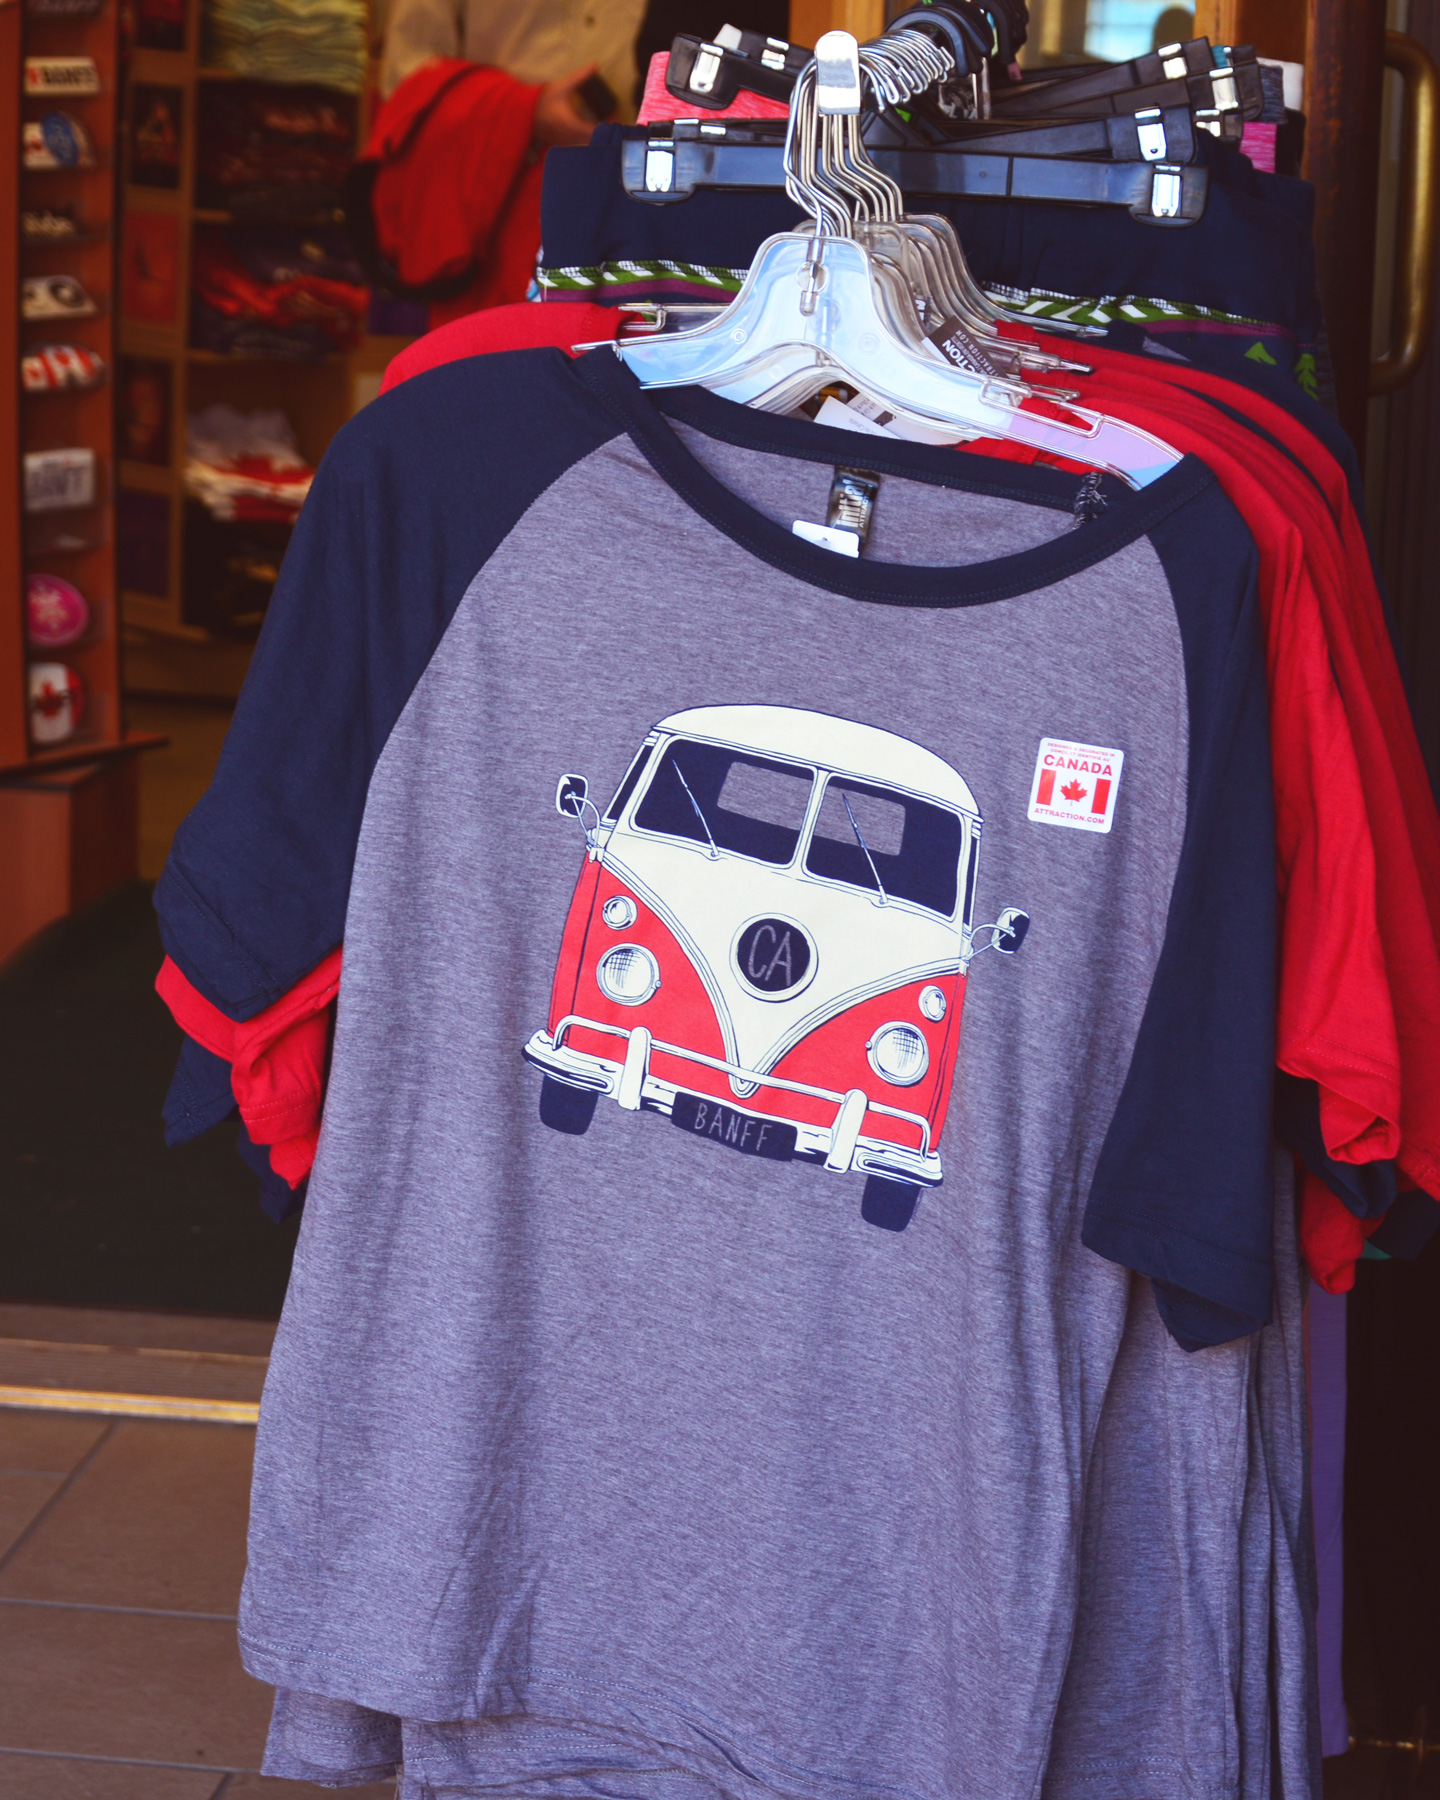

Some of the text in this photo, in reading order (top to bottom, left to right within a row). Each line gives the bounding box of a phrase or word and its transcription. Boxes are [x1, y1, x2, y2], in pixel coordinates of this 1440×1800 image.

[1044, 754, 1112, 776] CANADA
[1034, 807, 1105, 824] ATTRACTION.COM
[748, 925, 792, 987] CA
[694, 1102, 773, 1151] BANFF
